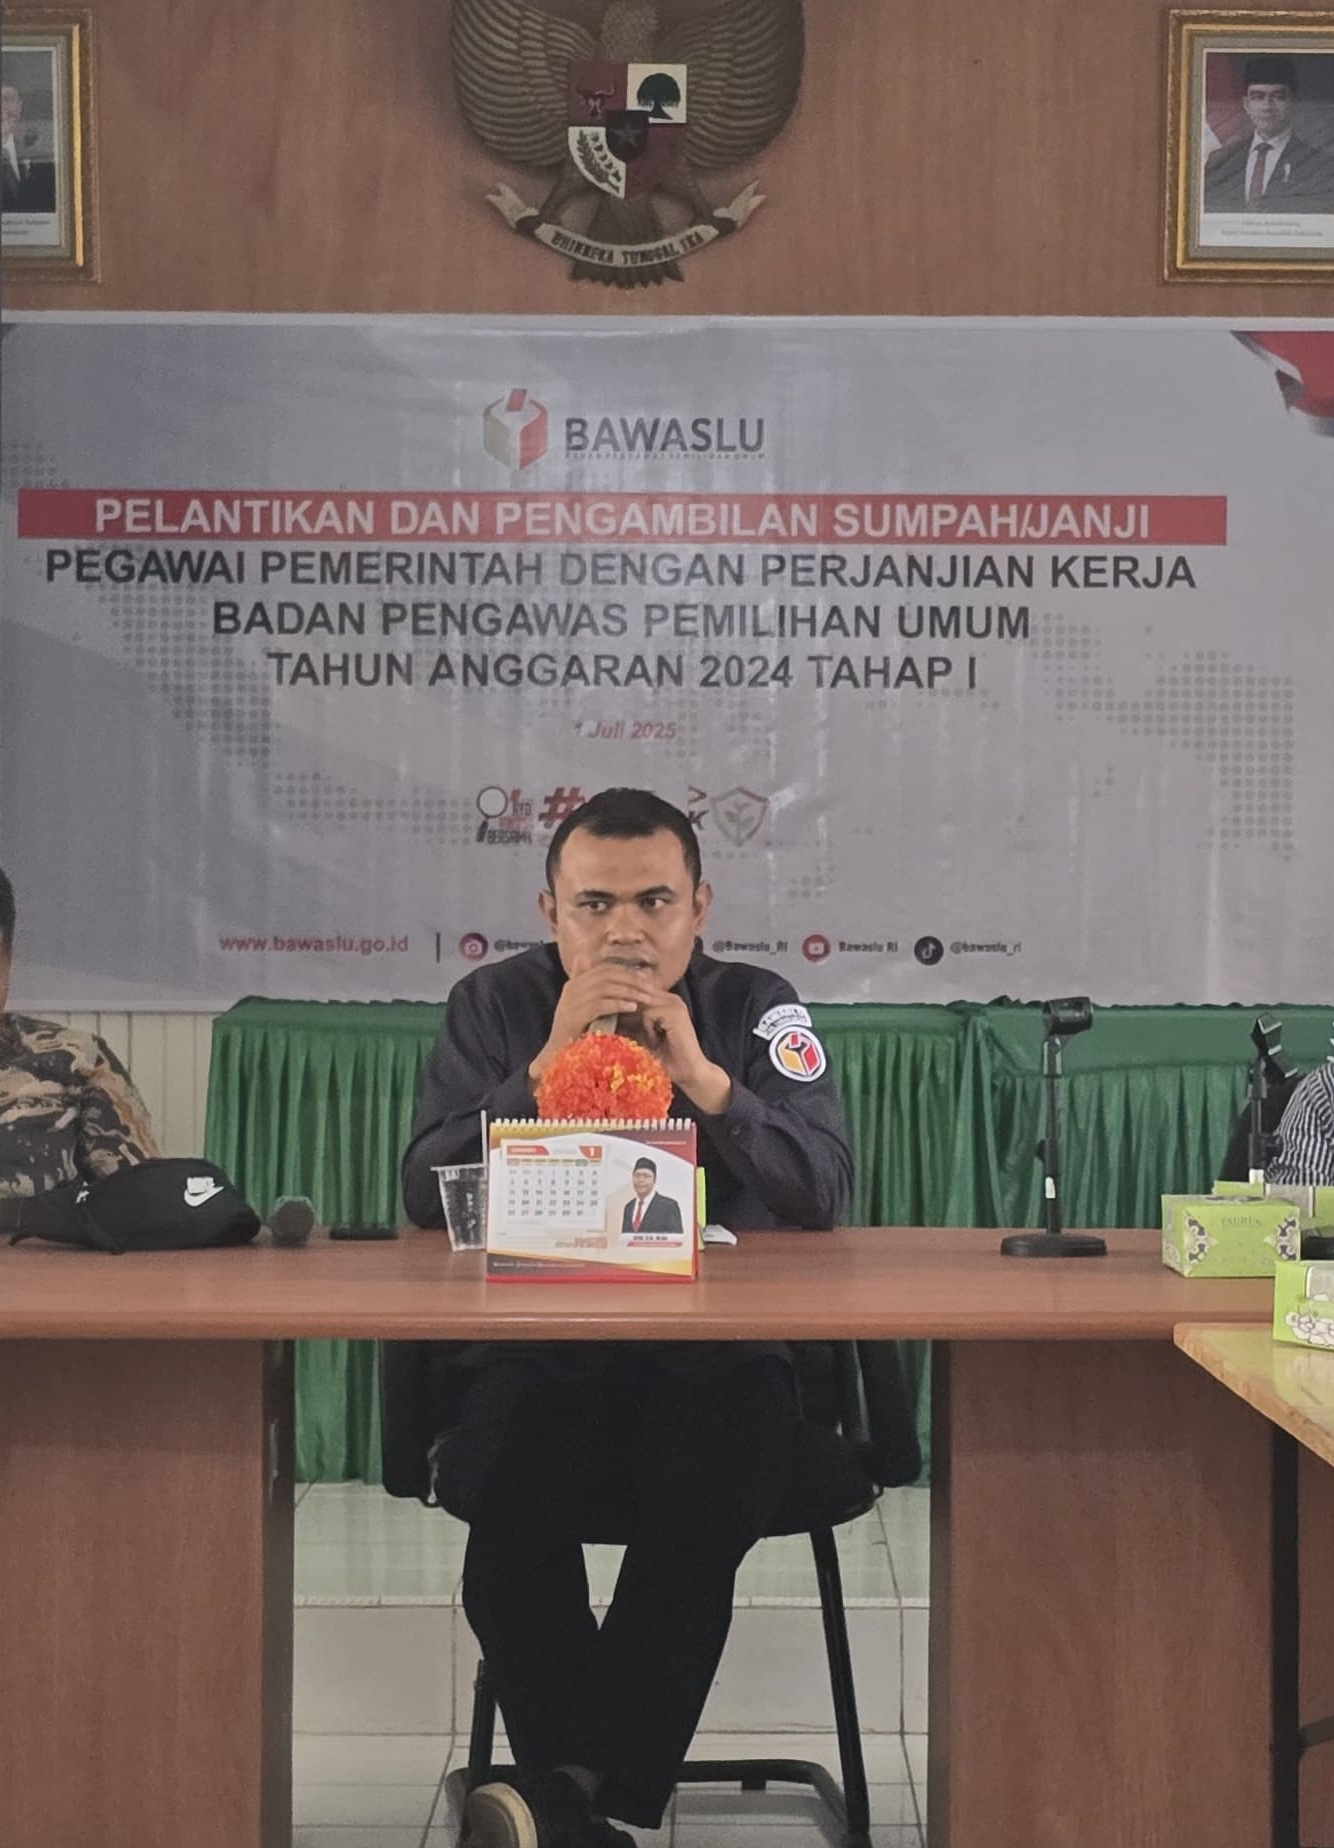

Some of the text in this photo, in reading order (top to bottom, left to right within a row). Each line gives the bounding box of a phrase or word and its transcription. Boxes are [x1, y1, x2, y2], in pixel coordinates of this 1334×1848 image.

[565, 416, 765, 452] BAWASLU
[95, 498, 1150, 541] PELANTIKAN DAN PENGAMBILAN SUMPAH/JANJI
[45, 549, 1197, 589] PEGAWAI PEMERINTAH DENGAN PERJANJIAN KERJA
[213, 601, 1031, 640] BADAN PENGAWAS PEMILIHAN UMUM
[267, 652, 978, 690] TAHUN ANGGARAN 2024 TAHAP I
[588, 719, 625, 739] Juli
[630, 720, 678, 740] 2025
[219, 934, 410, 956] www.bawaslu.go.id
